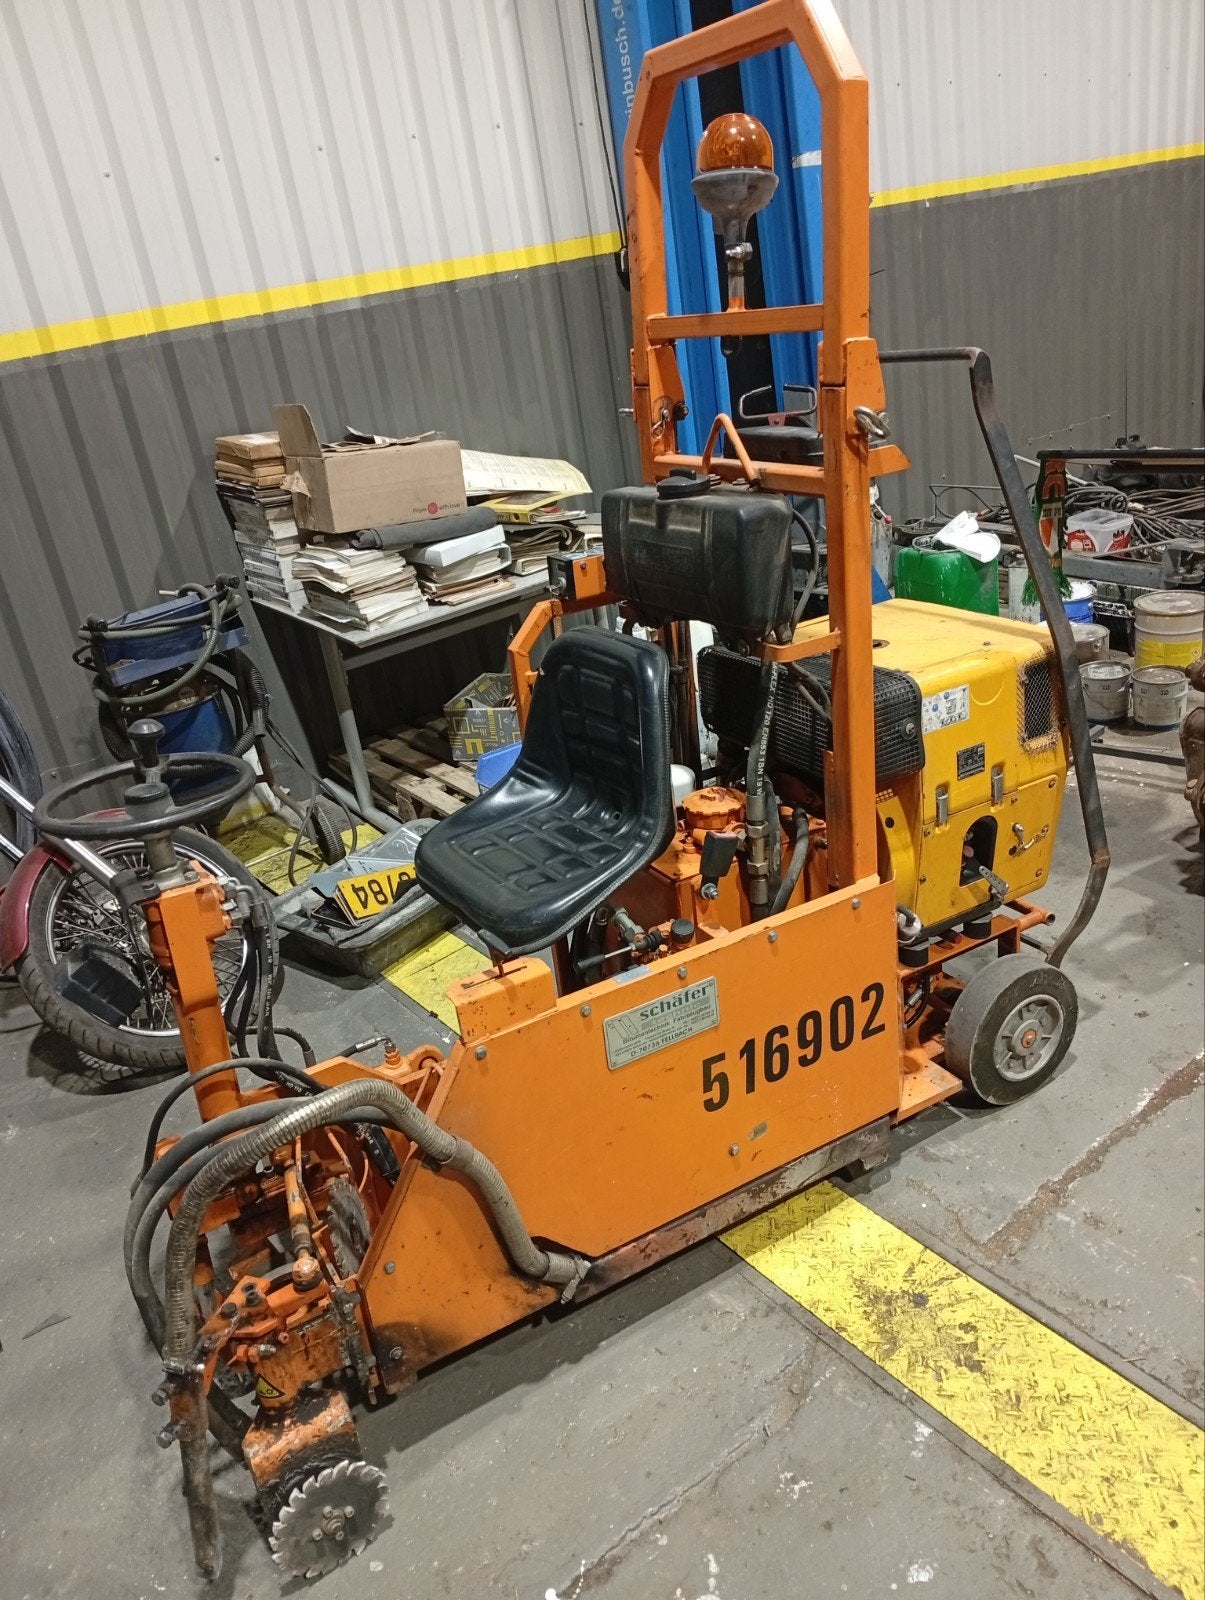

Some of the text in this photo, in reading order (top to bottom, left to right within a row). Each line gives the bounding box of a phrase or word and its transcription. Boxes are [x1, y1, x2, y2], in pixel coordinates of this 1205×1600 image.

[612, 0, 635, 118] inbusch.de
[623, 1021, 670, 1045] Bitumentechnik
[673, 1003, 712, 1024] Fahrzeugbau
[640, 985, 708, 1021] schäfer
[631, 1041, 660, 1057] D-70736
[661, 1026, 693, 1044] FELLBACH
[702, 982, 886, 1112] 516902
